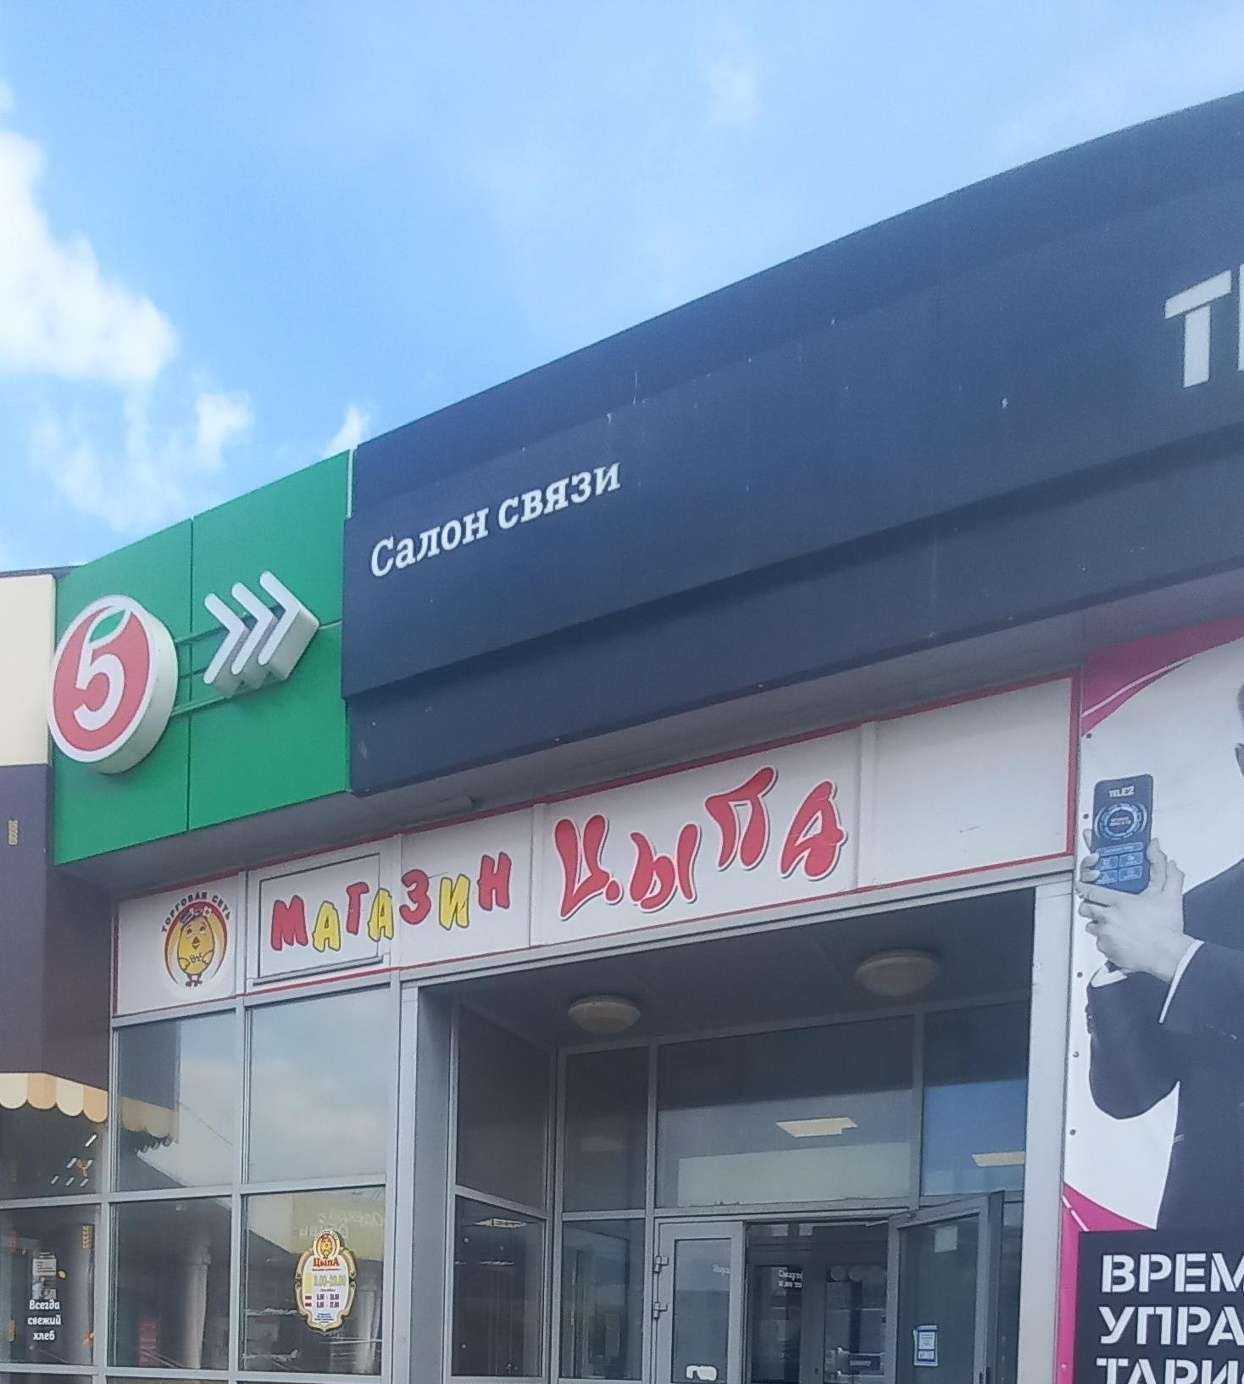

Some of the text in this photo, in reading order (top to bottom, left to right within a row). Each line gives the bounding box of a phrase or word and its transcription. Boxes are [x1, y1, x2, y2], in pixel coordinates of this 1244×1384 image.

[1164, 263, 1244, 388] T
[370, 462, 622, 577] Салон связи
[73, 608, 126, 731] 5
[553, 765, 847, 920] ЦЫПА
[161, 891, 207, 933] ТОРГОВАЯ
[270, 851, 513, 953] МАГАЗИН
[1101, 1252, 1244, 1293] ВРЕМ
[27, 1314, 61, 1325] свежий
[29, 1300, 60, 1310] Всегда
[1098, 1306, 1244, 1346] УПРА
[33, 1330, 55, 1341] хлеб
